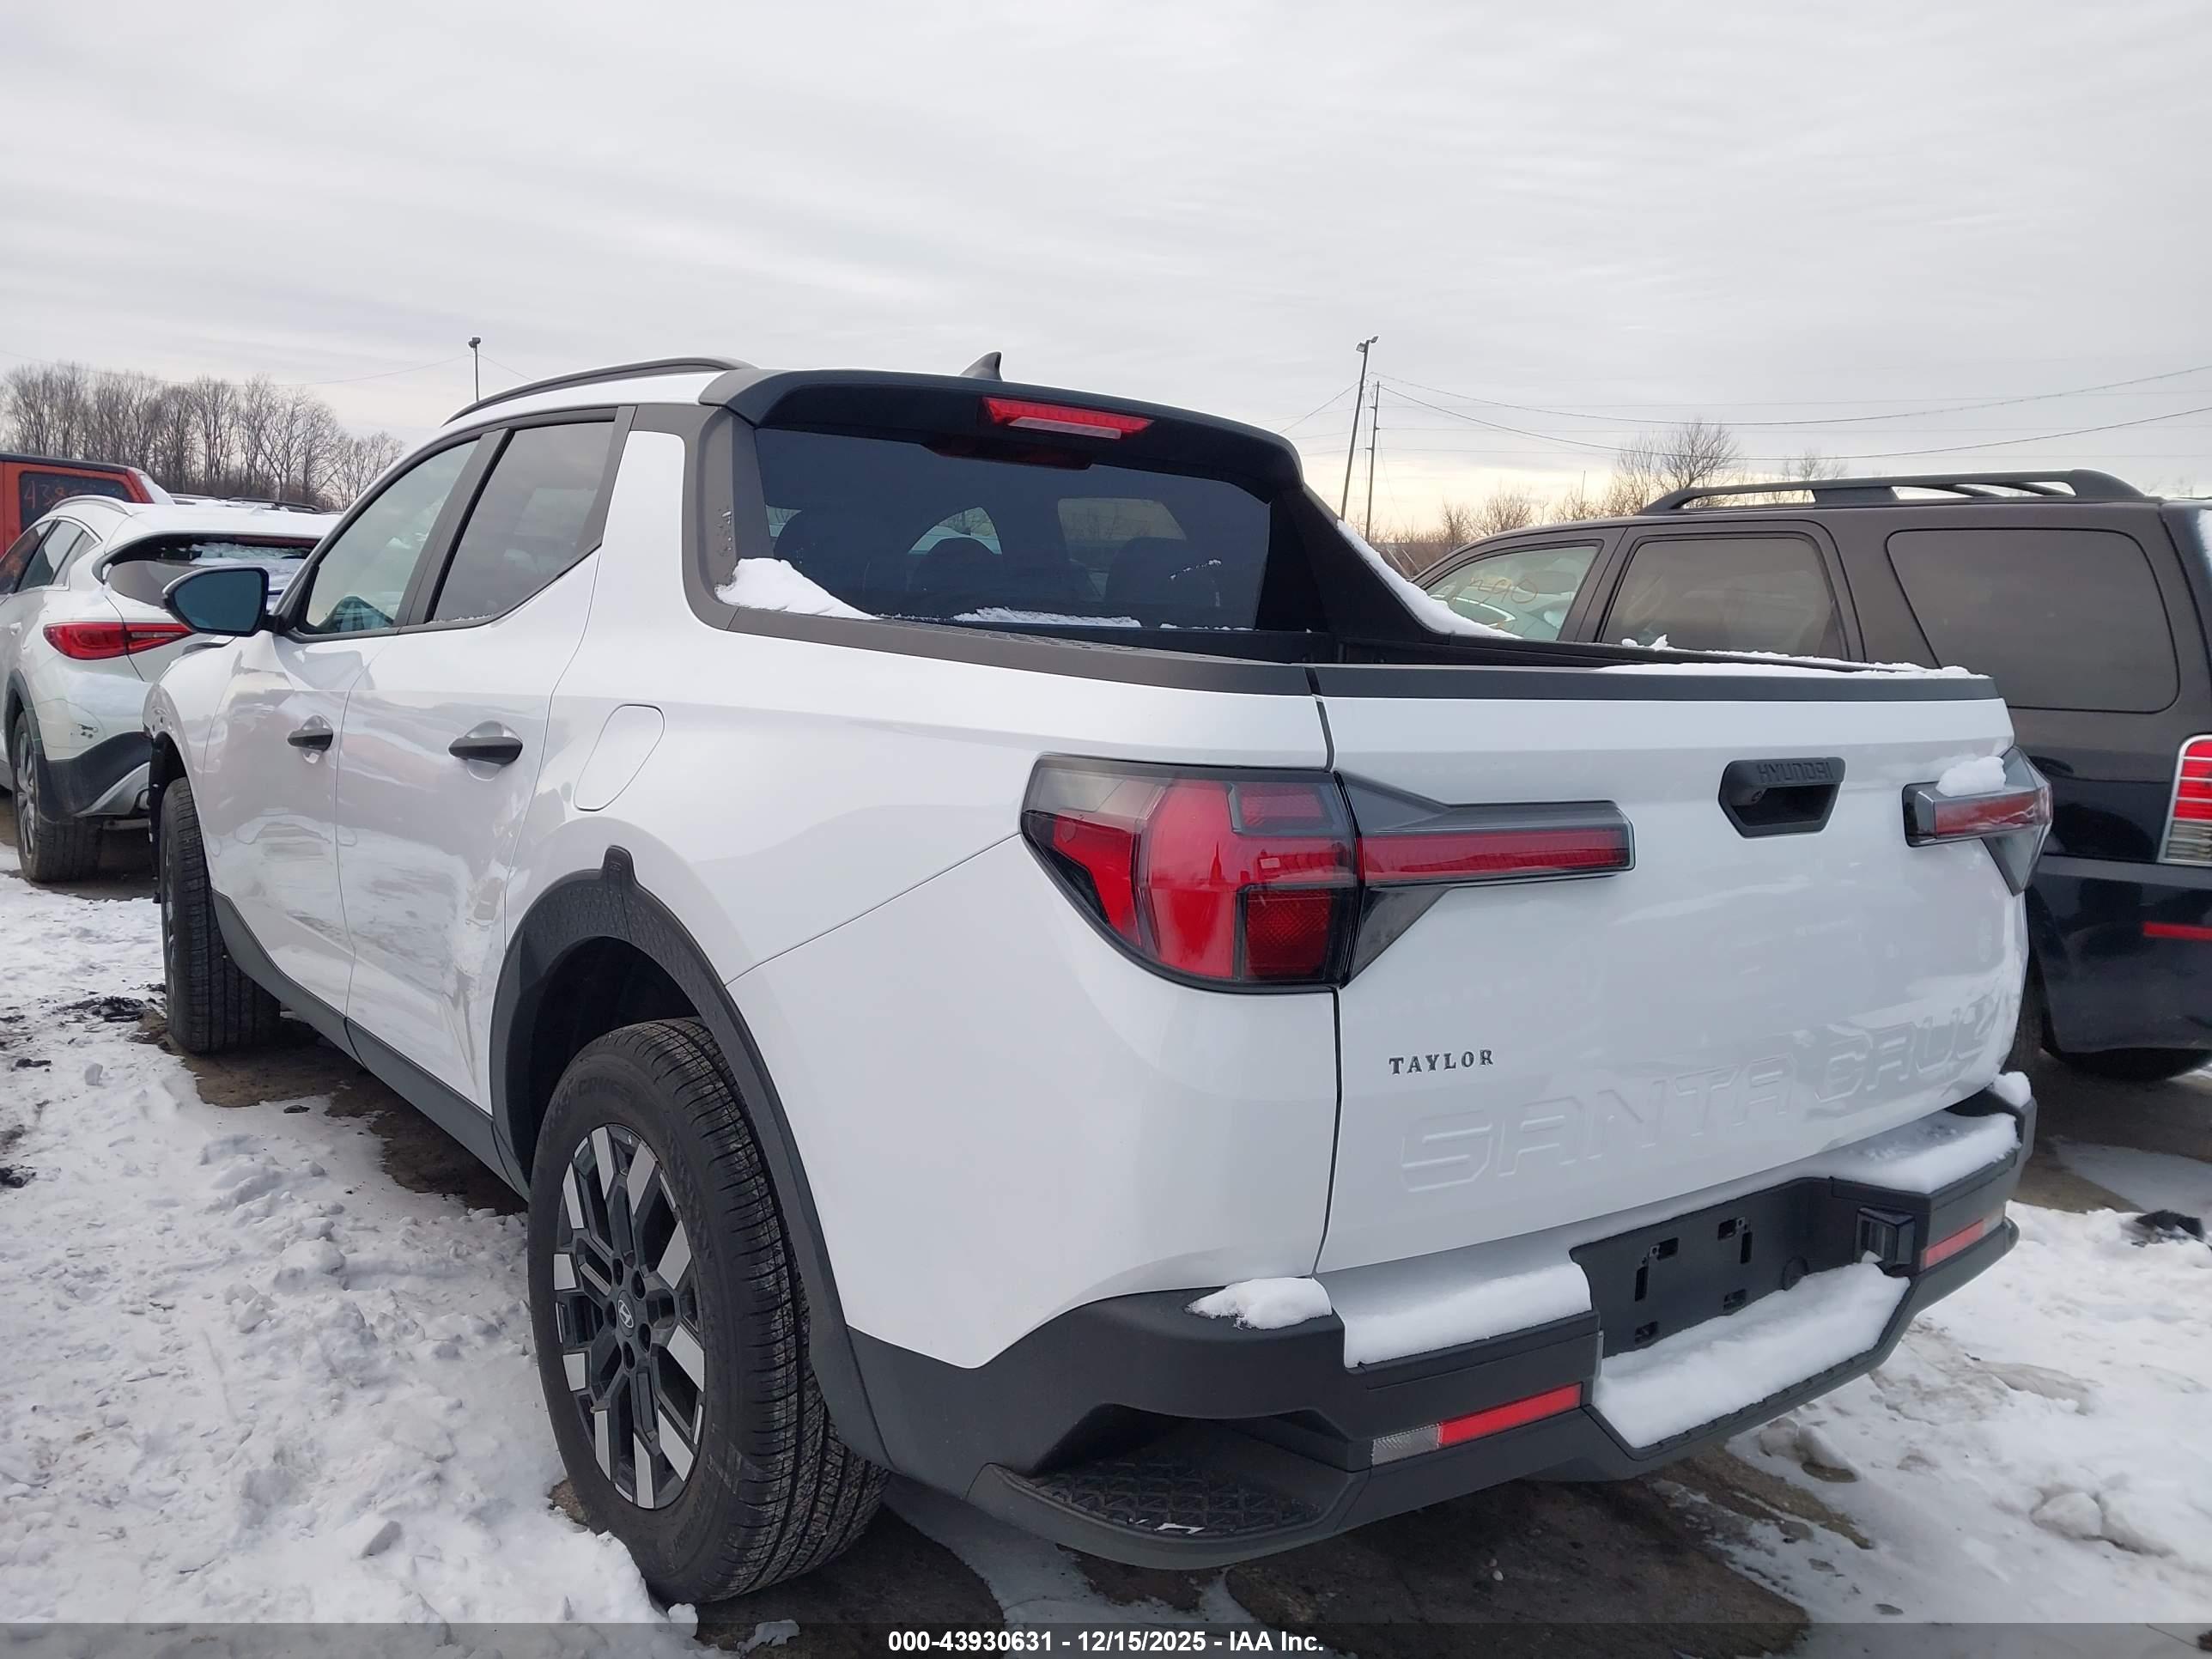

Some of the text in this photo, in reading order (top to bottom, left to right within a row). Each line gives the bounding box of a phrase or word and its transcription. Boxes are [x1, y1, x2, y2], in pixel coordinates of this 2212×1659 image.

[1757, 761, 1834, 783] HYUNDAI
[1389, 1049, 1495, 1075] TAYLOR
[1401, 1053, 1796, 1194] SANTA
